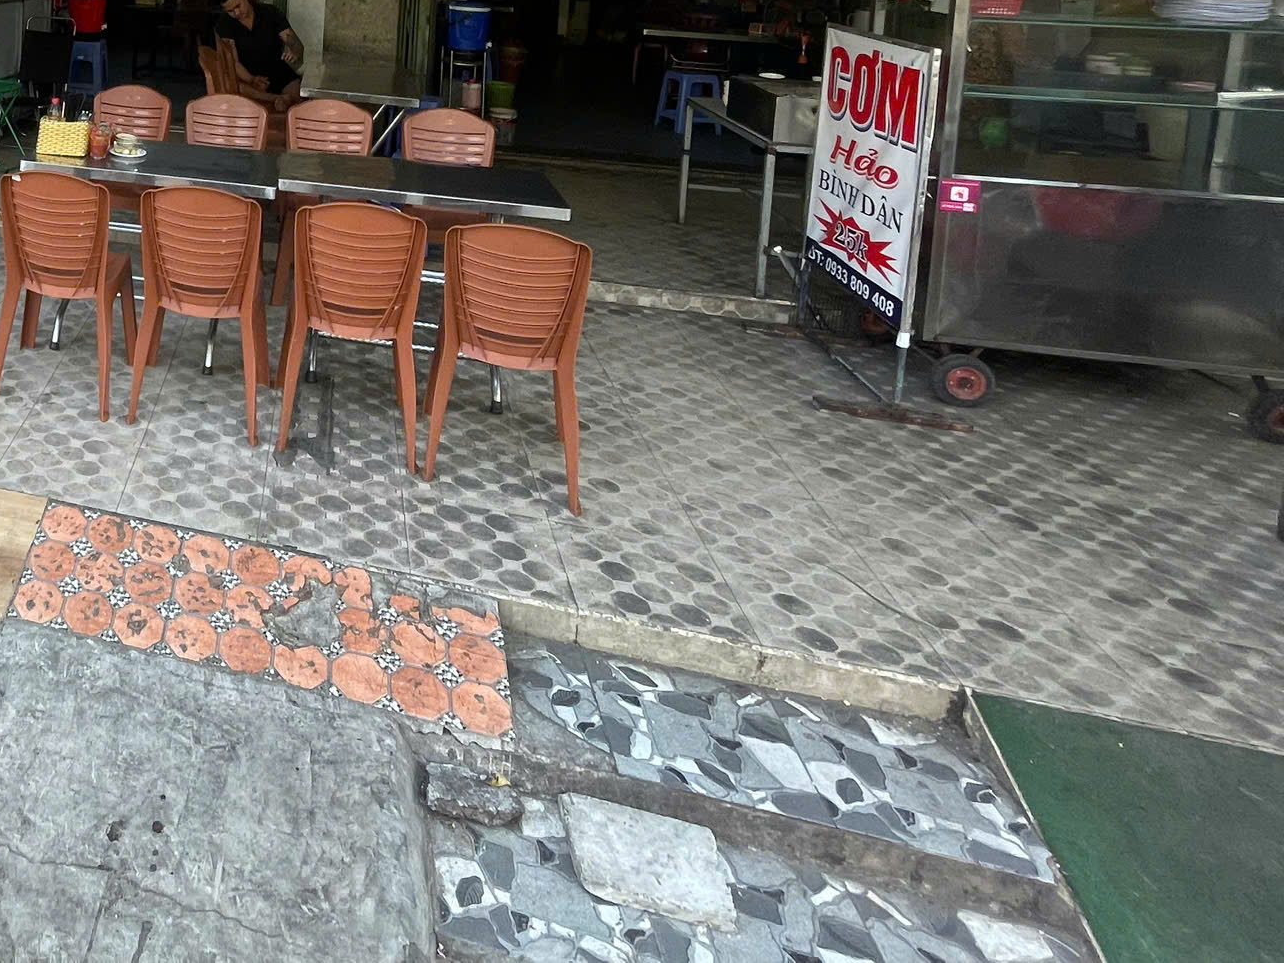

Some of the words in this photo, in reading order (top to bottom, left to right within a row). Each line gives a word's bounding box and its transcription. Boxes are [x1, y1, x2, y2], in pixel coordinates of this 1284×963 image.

[827, 45, 922, 150] CƠM
[829, 135, 900, 190] Hảo
[818, 168, 859, 208] BÌNH
[860, 195, 903, 234] DÂN
[825, 258, 849, 285] 0933
[850, 276, 870, 300] 809
[871, 292, 895, 318] 408
